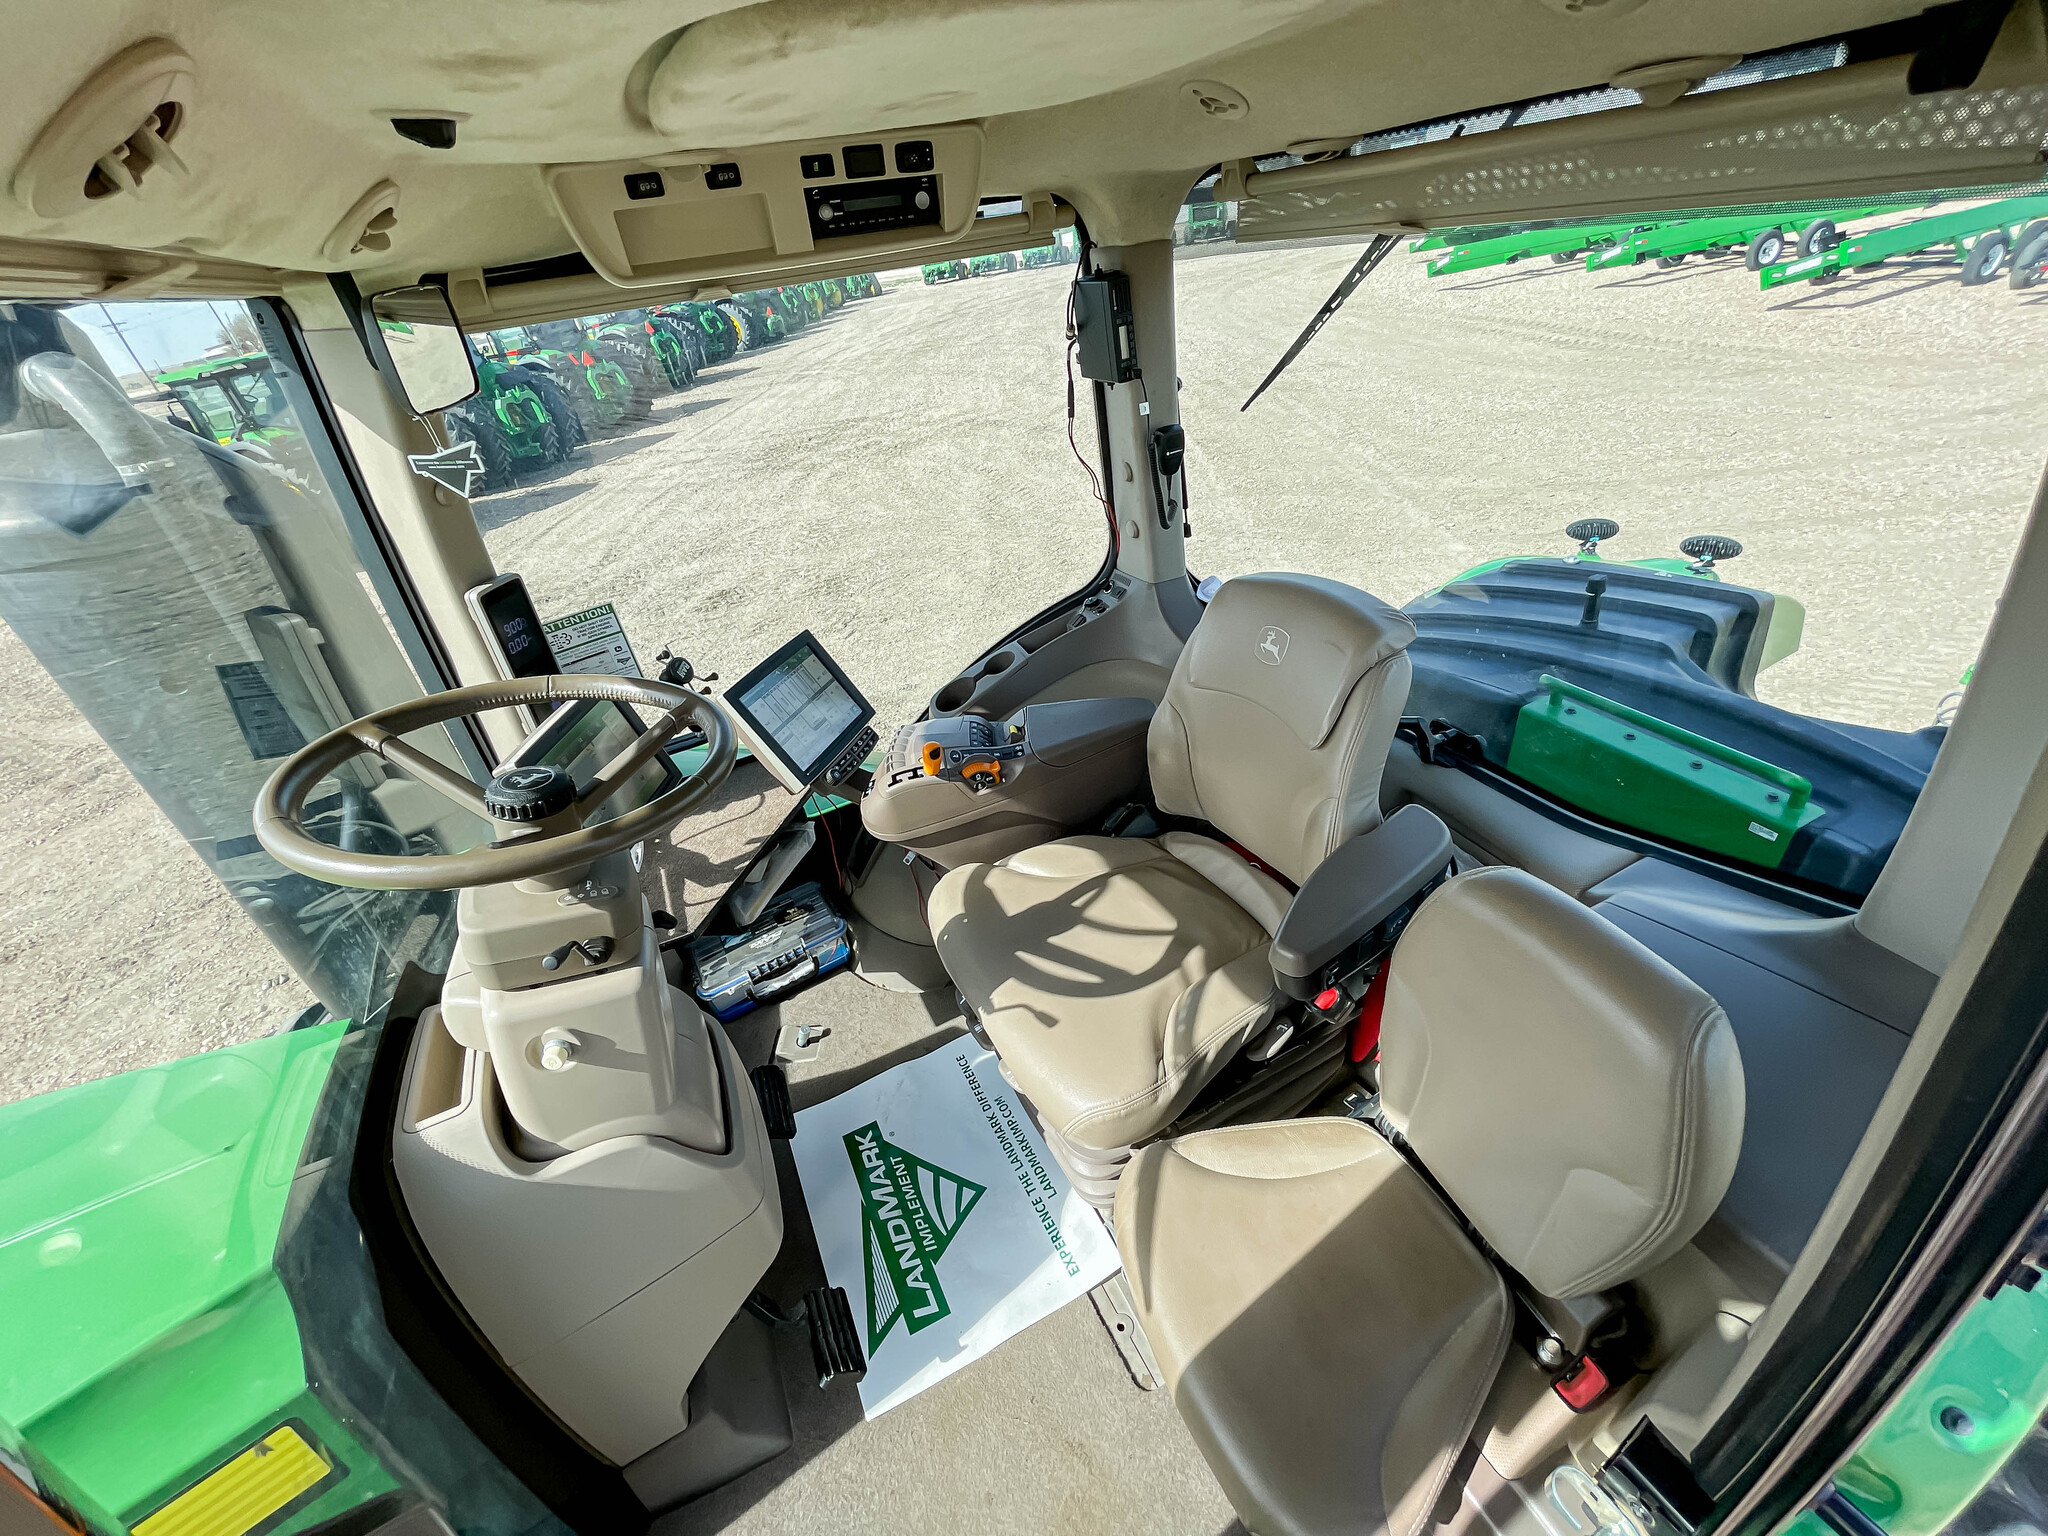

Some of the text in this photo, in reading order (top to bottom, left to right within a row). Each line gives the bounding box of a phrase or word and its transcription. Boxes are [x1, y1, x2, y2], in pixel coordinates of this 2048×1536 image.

[503, 617, 523, 637] 900
[543, 605, 611, 633] ATTENTION!
[677, 660, 690, 679] RAM
[955, 1053, 1081, 1277] EXPERIENCE THE LANDMARK DIFFERENCE
[994, 1095, 1058, 1200] LANDMARKIMP.COM
[854, 1130, 939, 1318] LANDMARK
[890, 1156, 937, 1252] IMPLEMENT
